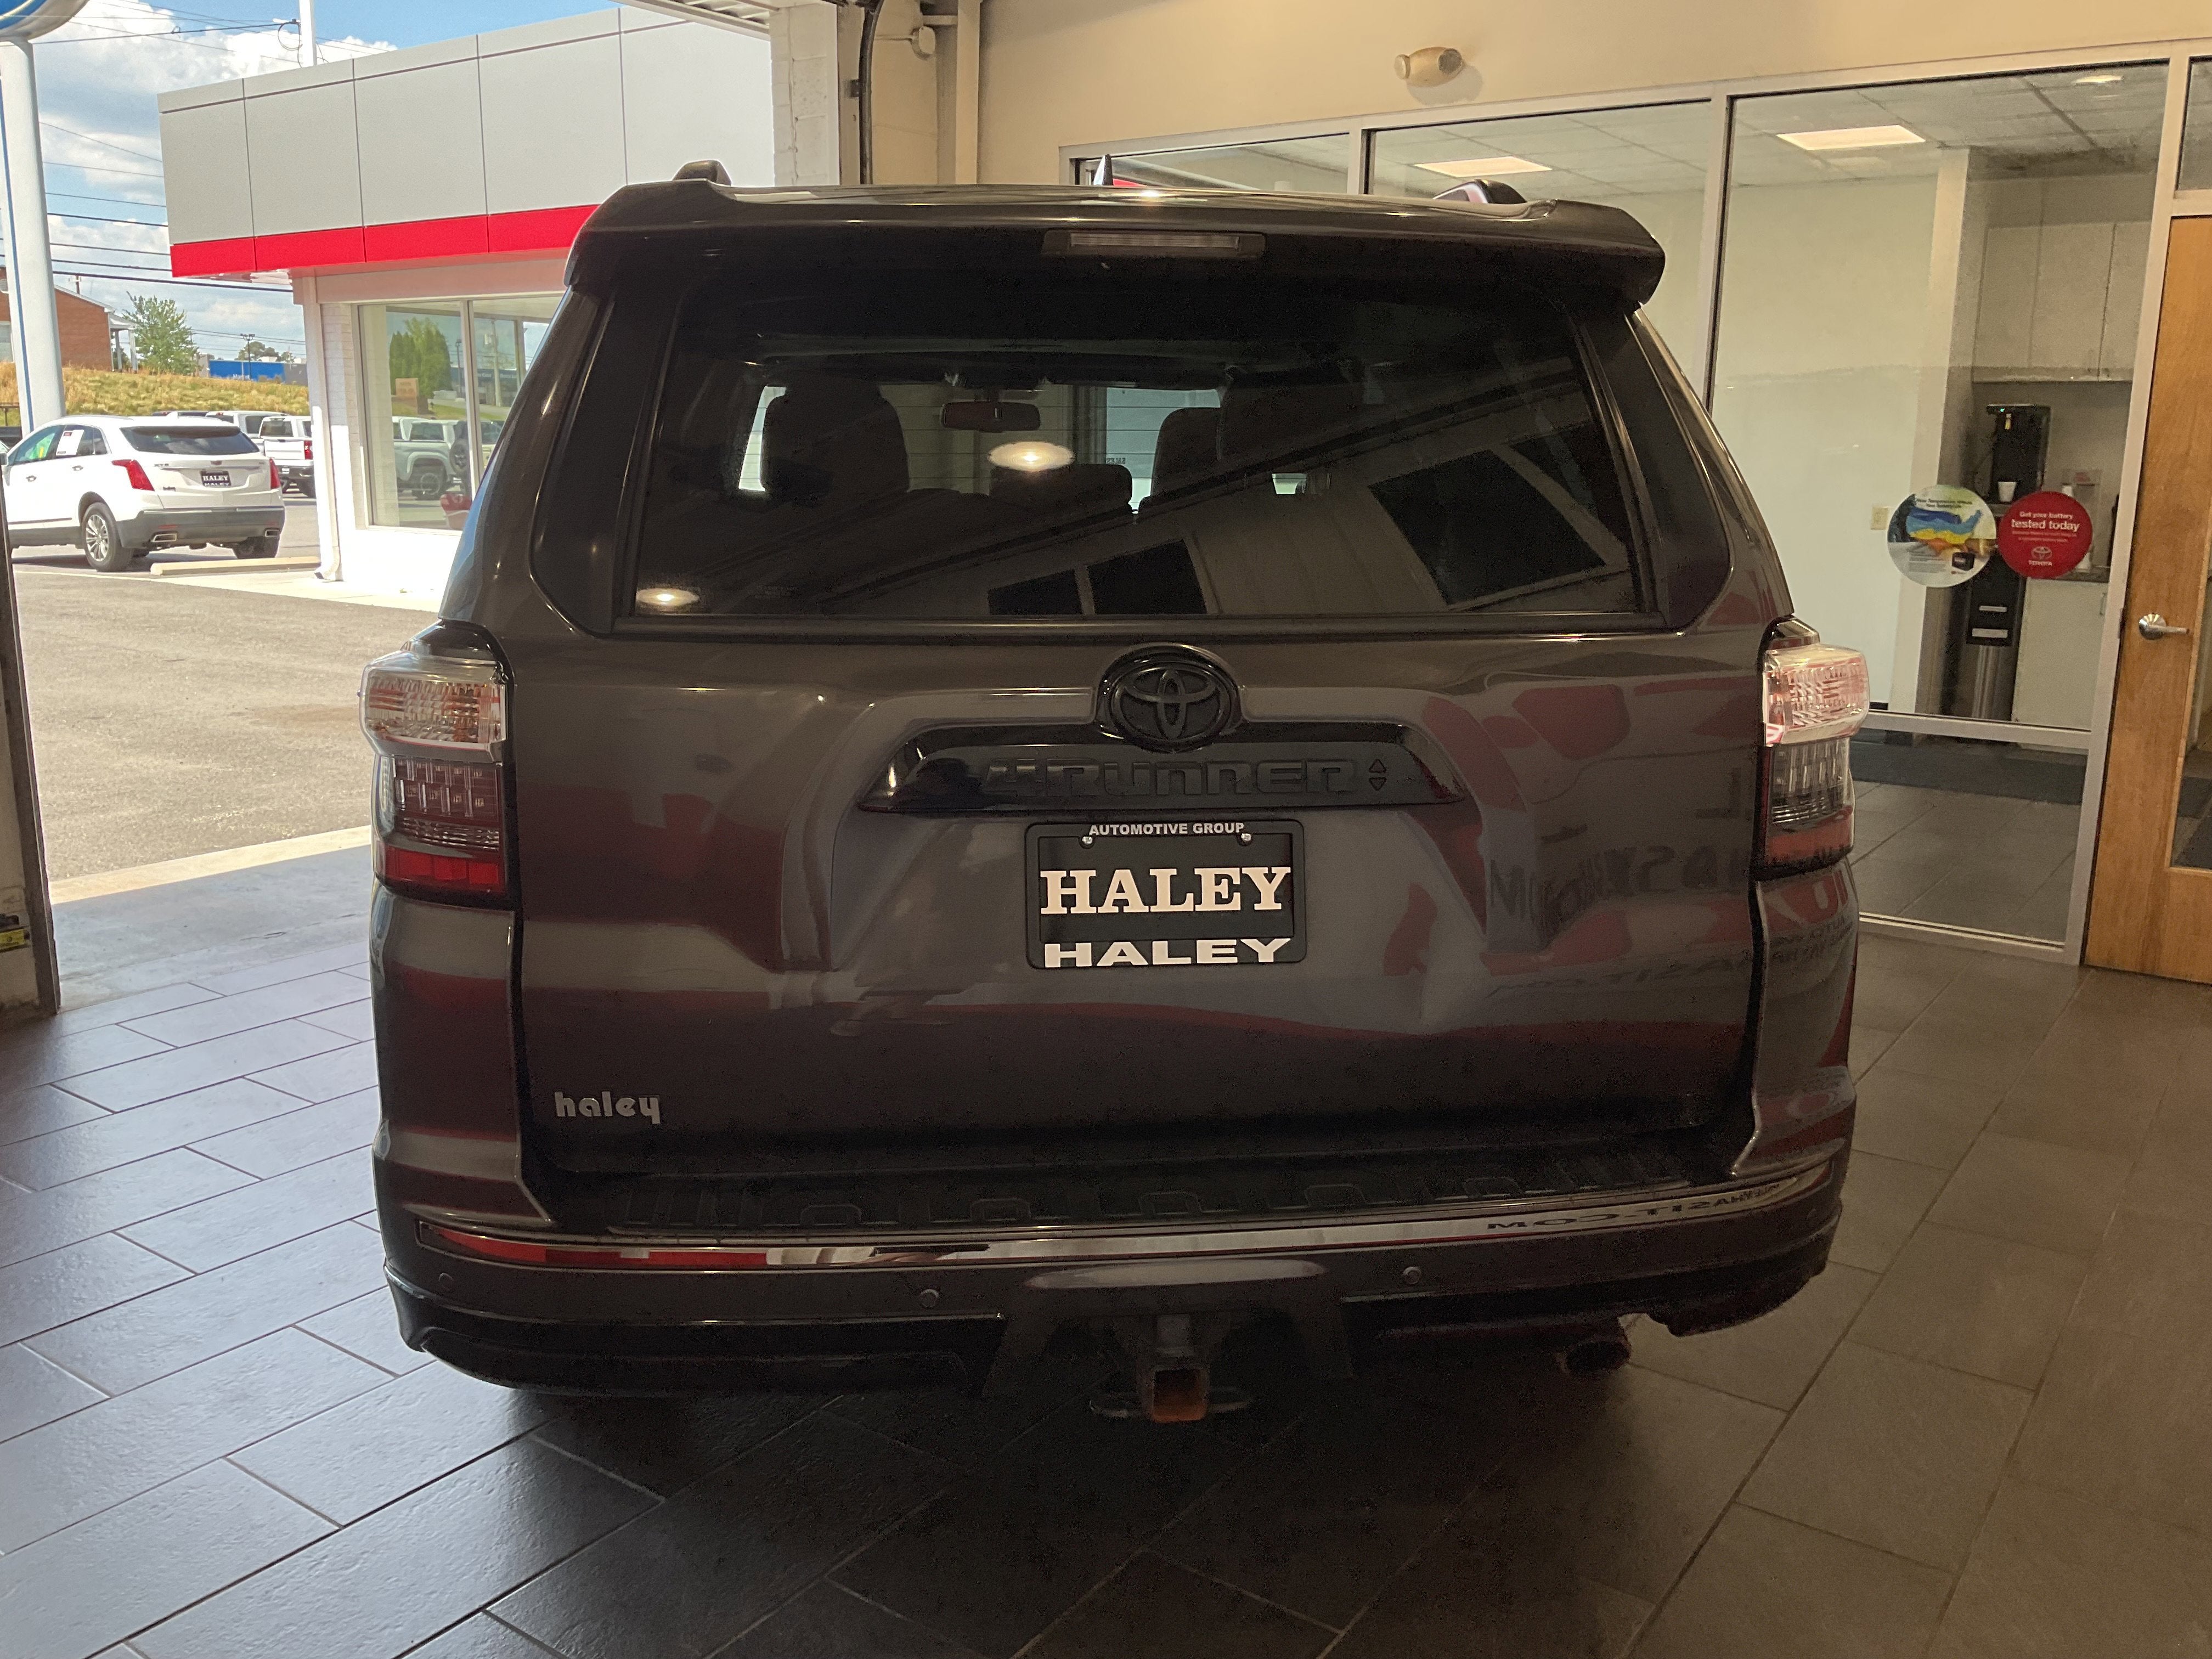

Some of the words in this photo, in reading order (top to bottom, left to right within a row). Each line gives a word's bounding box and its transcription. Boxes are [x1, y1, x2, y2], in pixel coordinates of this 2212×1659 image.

[2011, 519, 2046, 528] tested
[2049, 520, 2081, 532] today
[1089, 823, 1188, 835] AUTOMOTIVE
[1193, 822, 1244, 833] GROUP
[1040, 867, 1291, 914] HALEY
[1045, 938, 1291, 968] HALEY
[555, 1091, 660, 1124] haley
